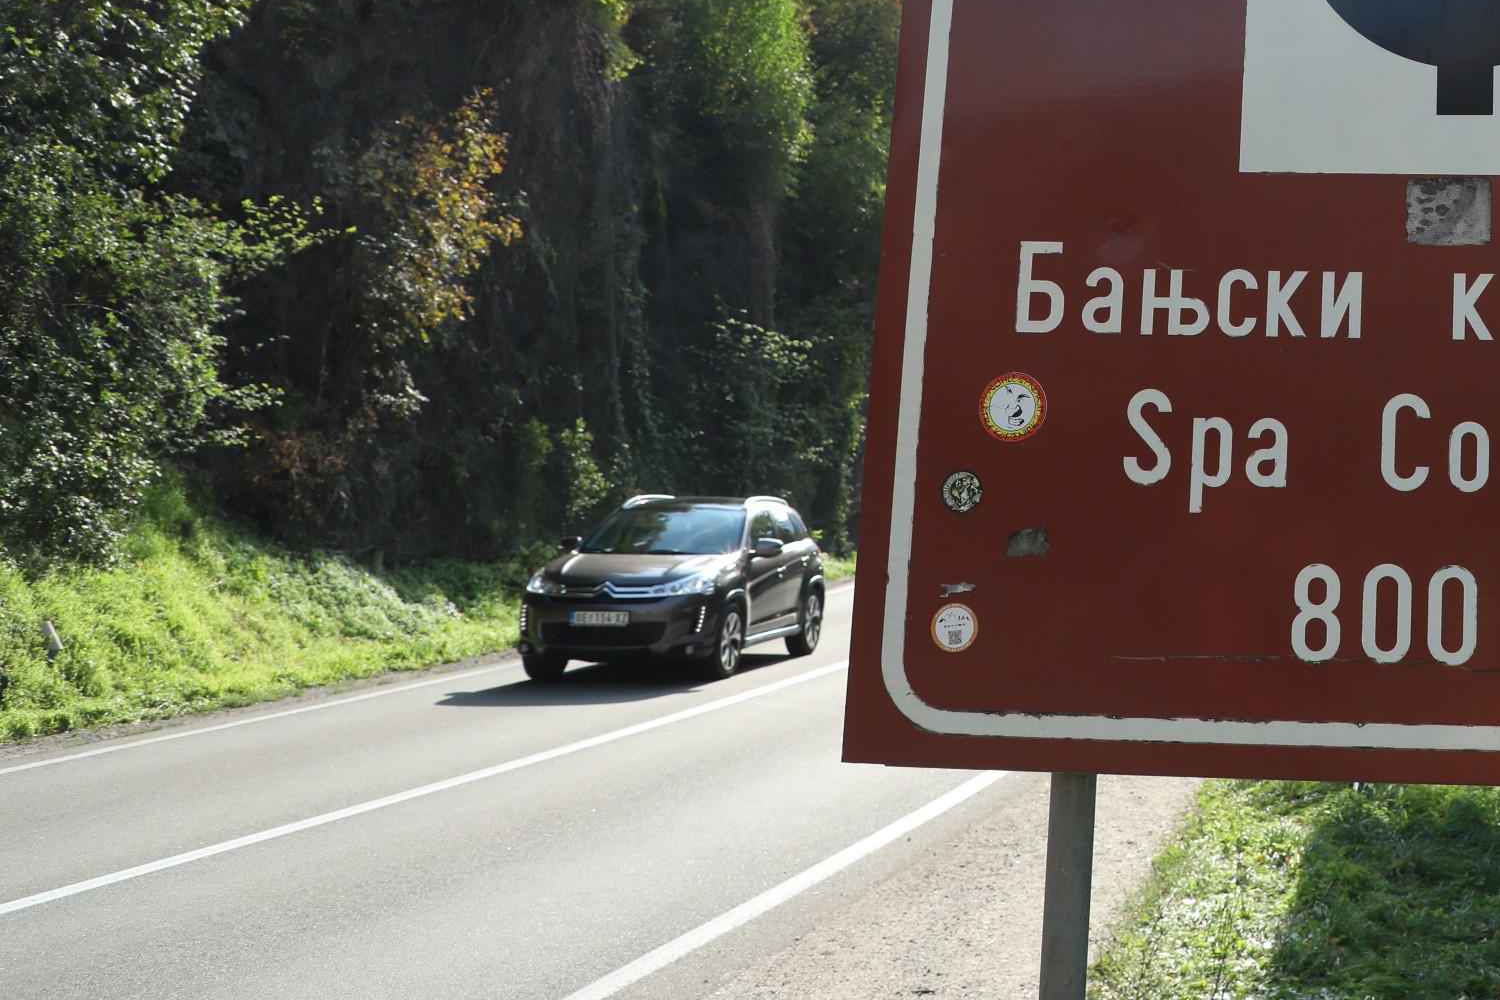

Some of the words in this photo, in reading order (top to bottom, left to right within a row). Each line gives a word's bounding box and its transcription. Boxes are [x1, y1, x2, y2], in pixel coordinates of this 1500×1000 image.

[1015, 241, 1363, 339] Бањски
[1123, 388, 1288, 514] Spa
[1291, 563, 1478, 666] 800
